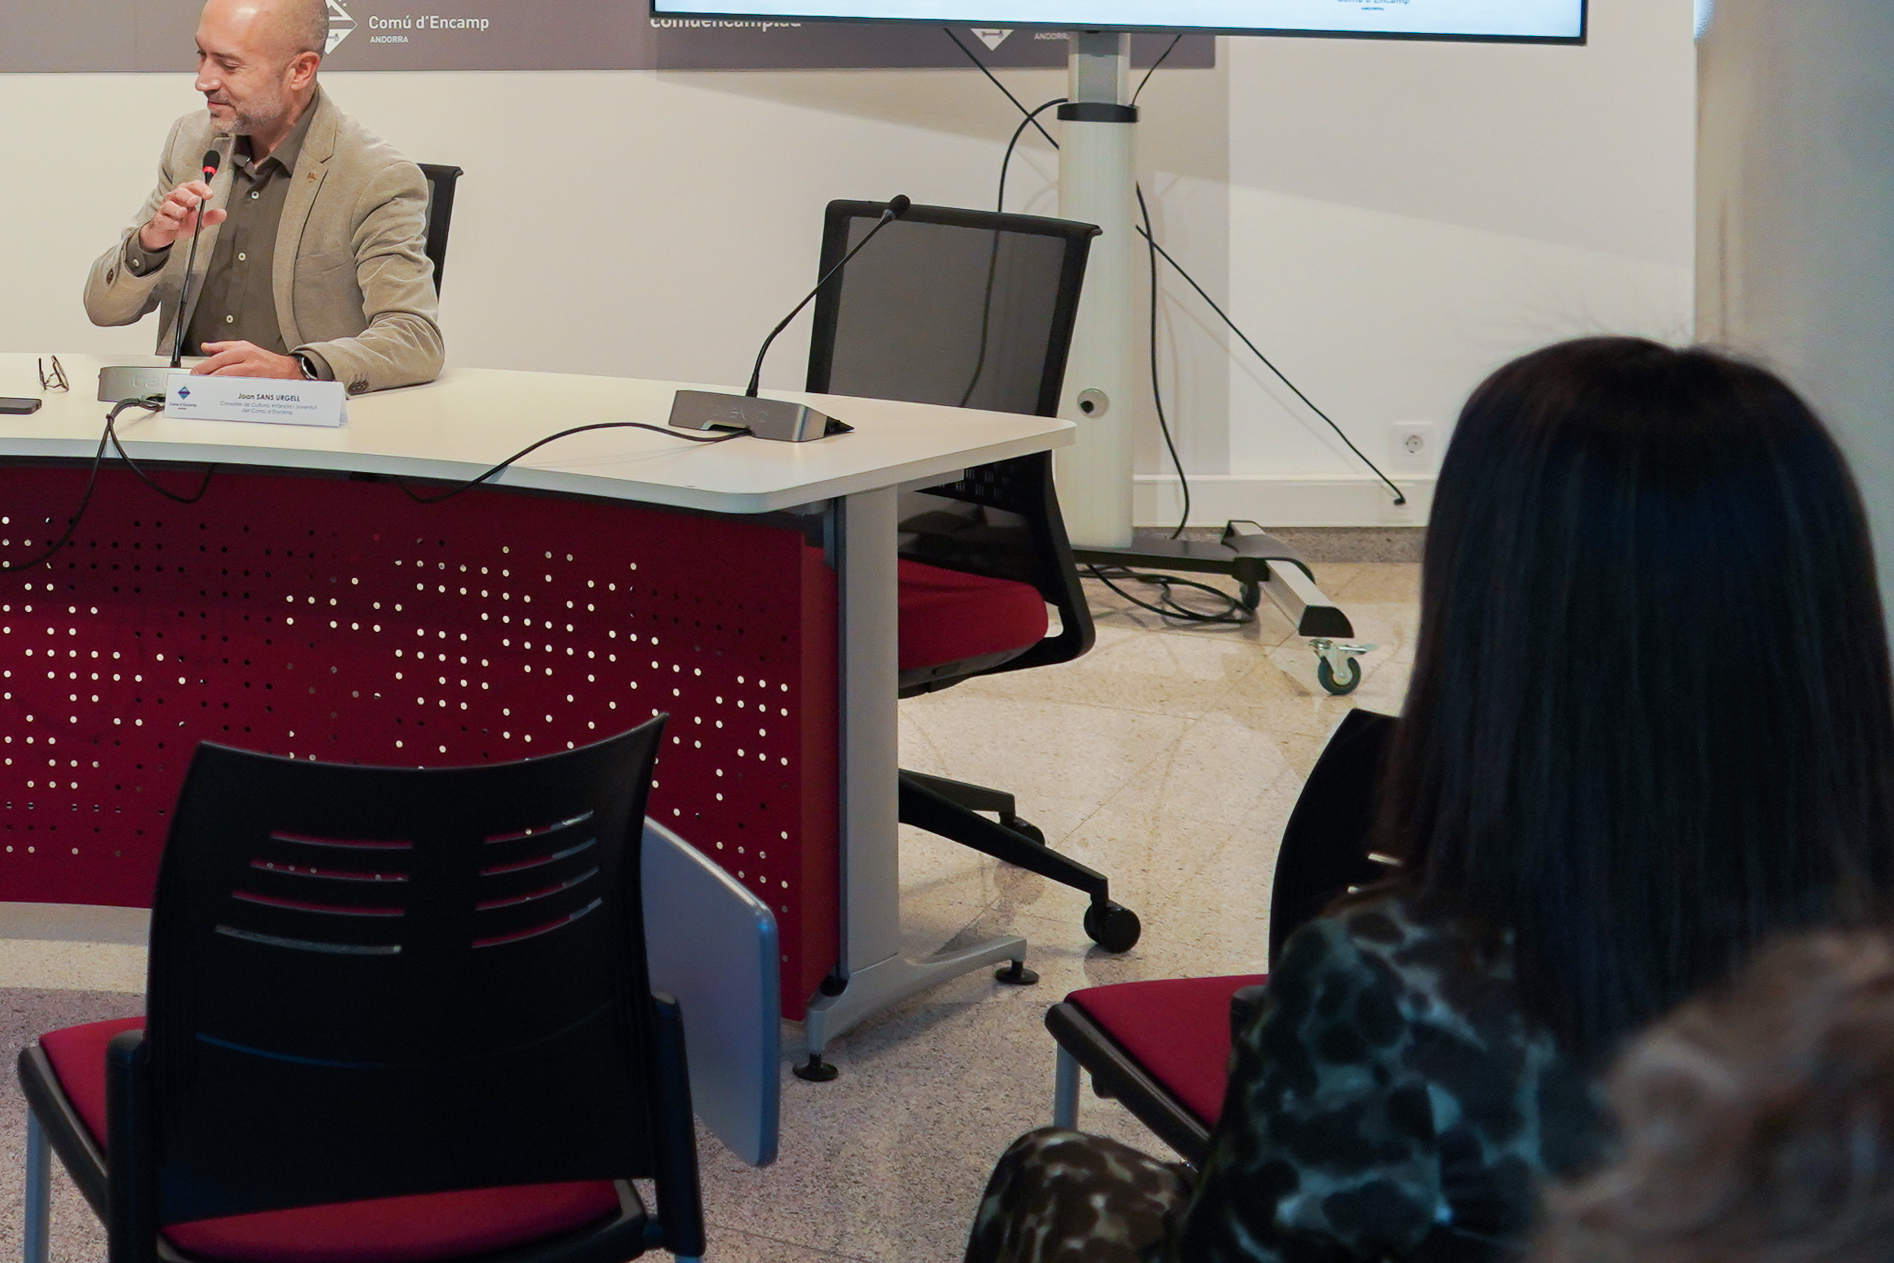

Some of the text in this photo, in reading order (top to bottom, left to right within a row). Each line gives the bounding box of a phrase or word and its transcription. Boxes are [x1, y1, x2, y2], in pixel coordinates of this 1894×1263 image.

[368, 14, 490, 32] Comú d'Encamp
[369, 36, 409, 44] ANDORRA
[256, 393, 274, 401] SANS
[276, 394, 300, 402] URGELL
